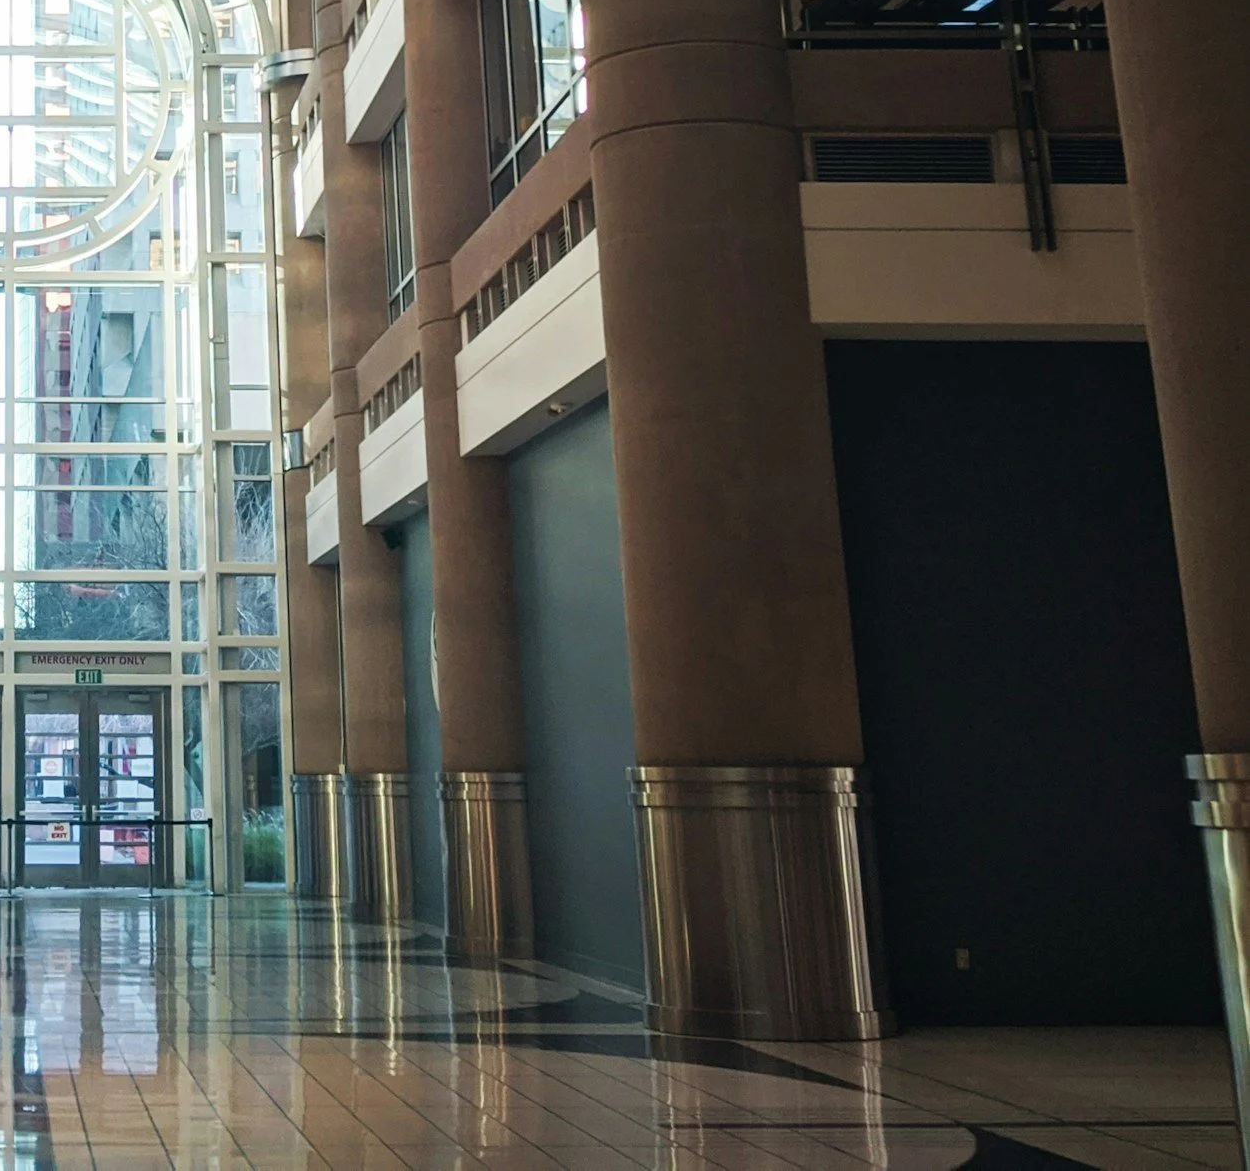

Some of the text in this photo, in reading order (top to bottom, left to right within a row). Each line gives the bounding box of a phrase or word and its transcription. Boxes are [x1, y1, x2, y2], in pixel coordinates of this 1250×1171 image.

[31, 655, 147, 665] EMERGENCY EXIT ONLY
[78, 670, 99, 683] EXIT
